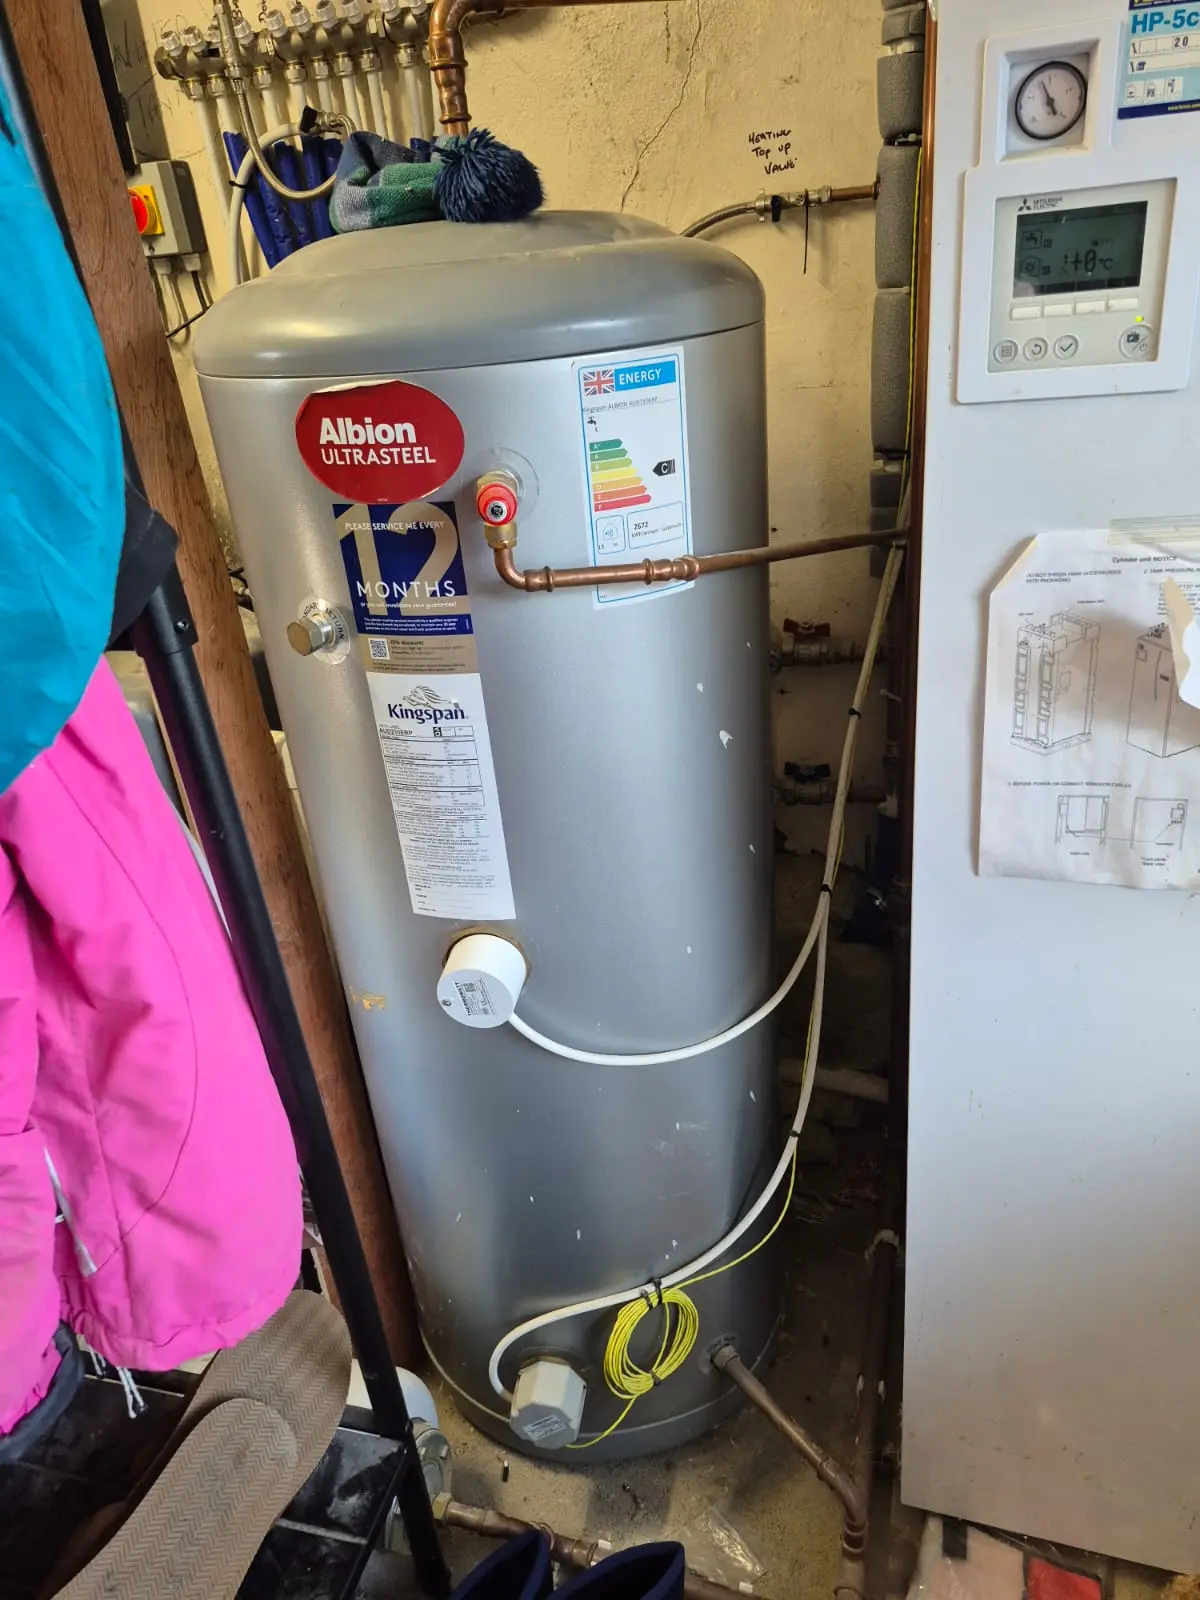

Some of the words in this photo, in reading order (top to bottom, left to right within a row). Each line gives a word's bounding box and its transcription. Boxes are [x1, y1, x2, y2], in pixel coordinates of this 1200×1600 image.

[619, 368, 662, 385] ENERGY
[319, 417, 417, 445] Albion
[321, 446, 437, 465] ULTRASTEEL
[661, 462, 669, 474] C
[345, 522, 371, 531] PLEASE
[372, 522, 405, 531] SERVICE
[406, 522, 418, 530] ME
[419, 520, 445, 530] EVERY
[356, 580, 456, 598] MONTHS
[387, 703, 465, 724] Kingspan
